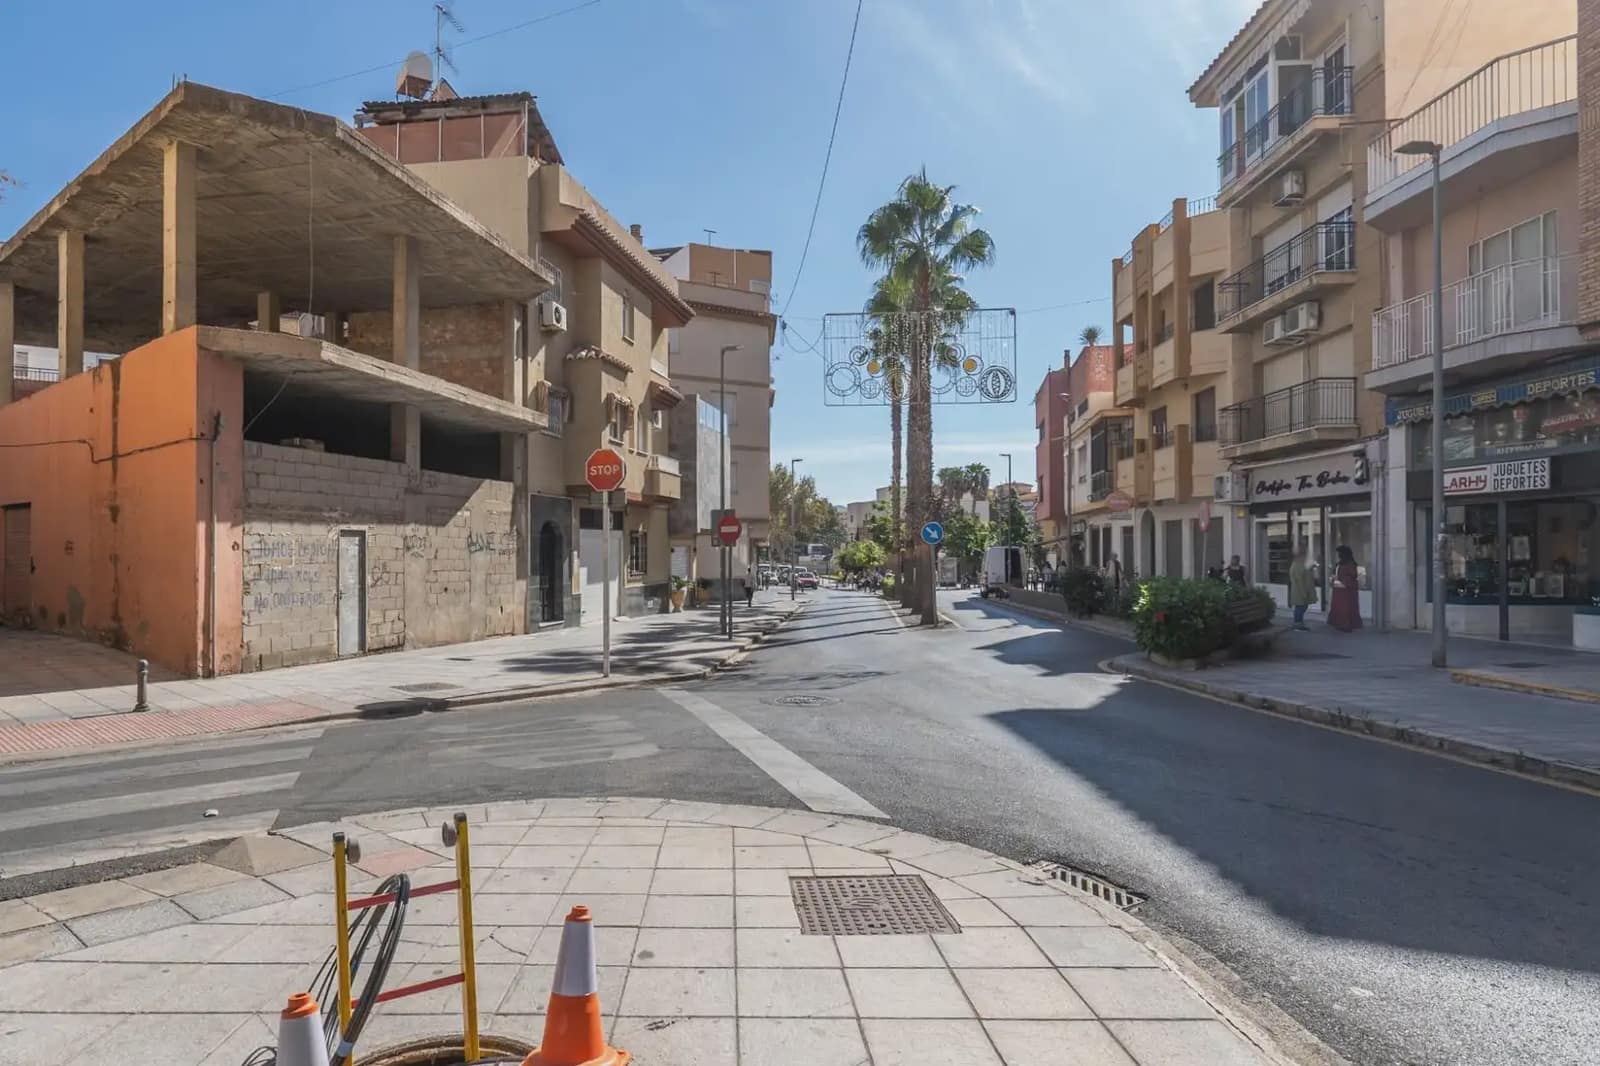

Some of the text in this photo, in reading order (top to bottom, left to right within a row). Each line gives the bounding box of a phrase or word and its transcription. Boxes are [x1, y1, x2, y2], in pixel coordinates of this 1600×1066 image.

[1528, 371, 1596, 395] DEPORTES
[590, 465, 620, 476] STOP
[1493, 460, 1546, 477] JUGUETES
[1493, 475, 1546, 491] DEPORTES
